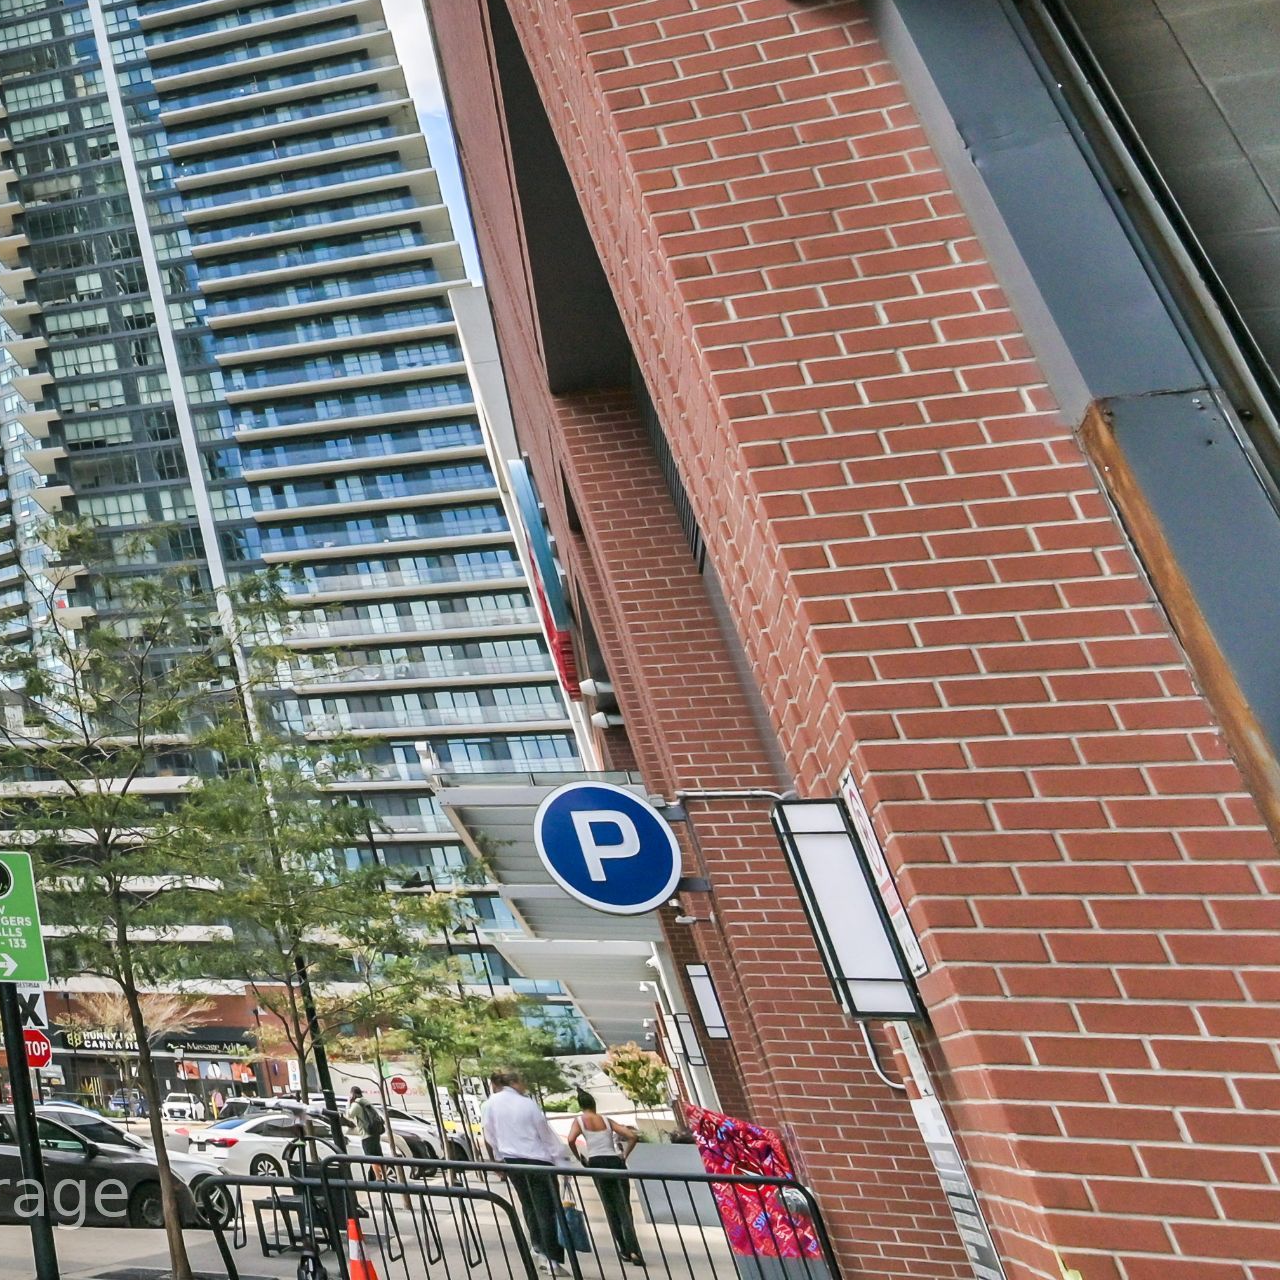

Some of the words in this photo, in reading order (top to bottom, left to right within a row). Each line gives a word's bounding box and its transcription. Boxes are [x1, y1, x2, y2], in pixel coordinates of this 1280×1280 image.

[570, 809, 641, 881] P
[8, 938, 27, 949] 133
[25, 1040, 48, 1057] TOP
[392, 1082, 406, 1090] STOP
